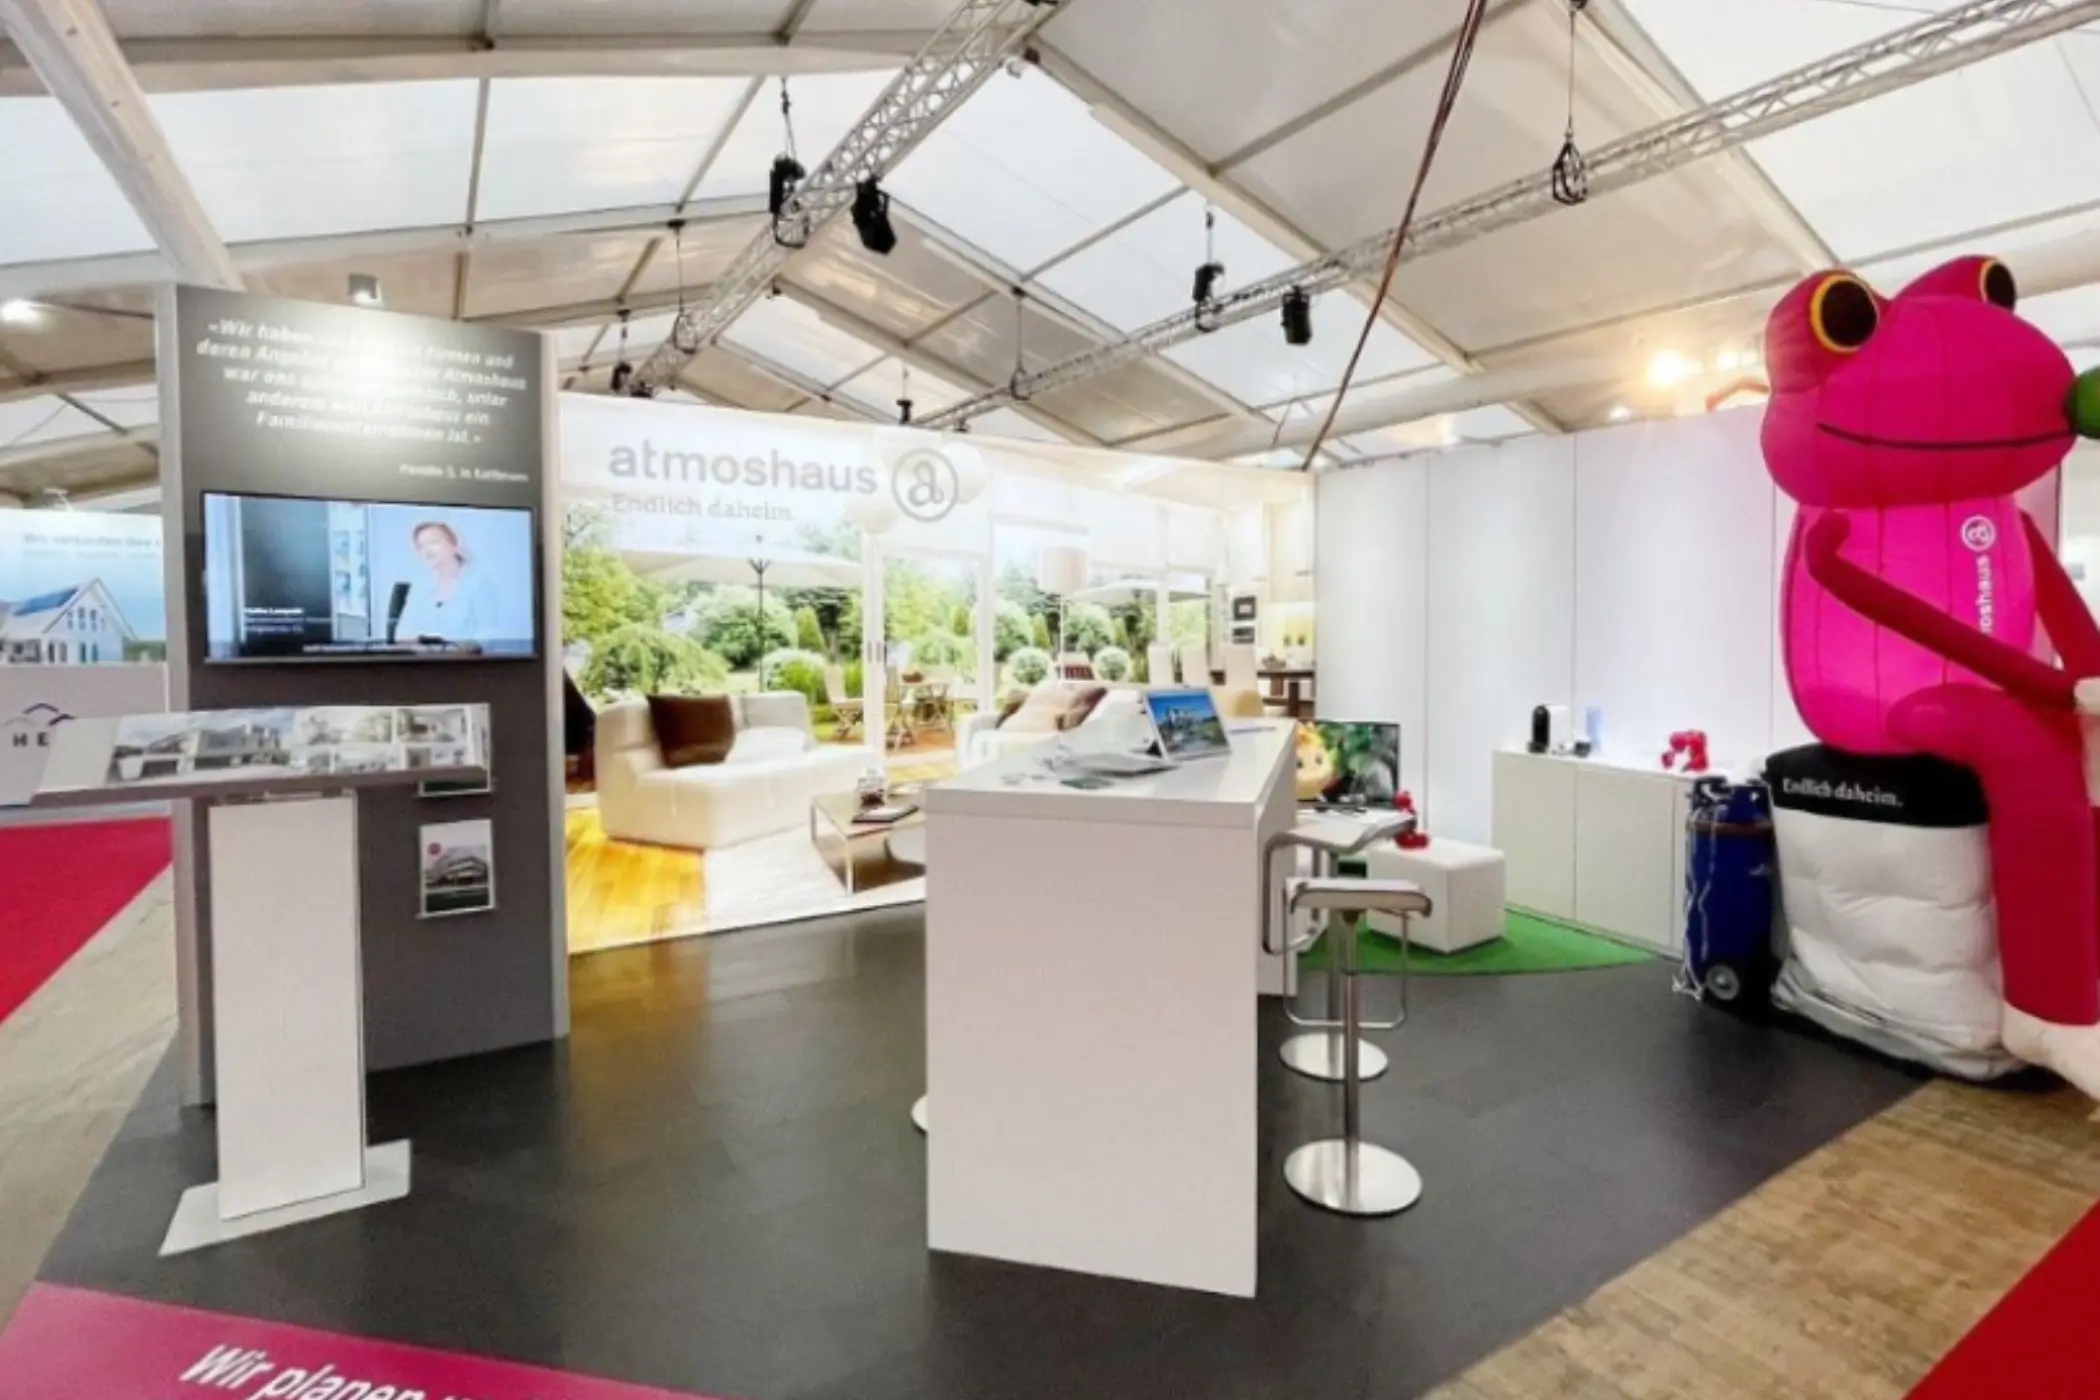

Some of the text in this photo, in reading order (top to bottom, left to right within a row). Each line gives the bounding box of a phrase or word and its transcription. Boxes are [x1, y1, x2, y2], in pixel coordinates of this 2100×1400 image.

[608, 440, 878, 494] atmoshaus
[611, 493, 703, 517] Endlich
[1975, 554, 1993, 634] oshaus
[1782, 778, 1832, 799] Endlich
[180, 1344, 275, 1389] Wir
